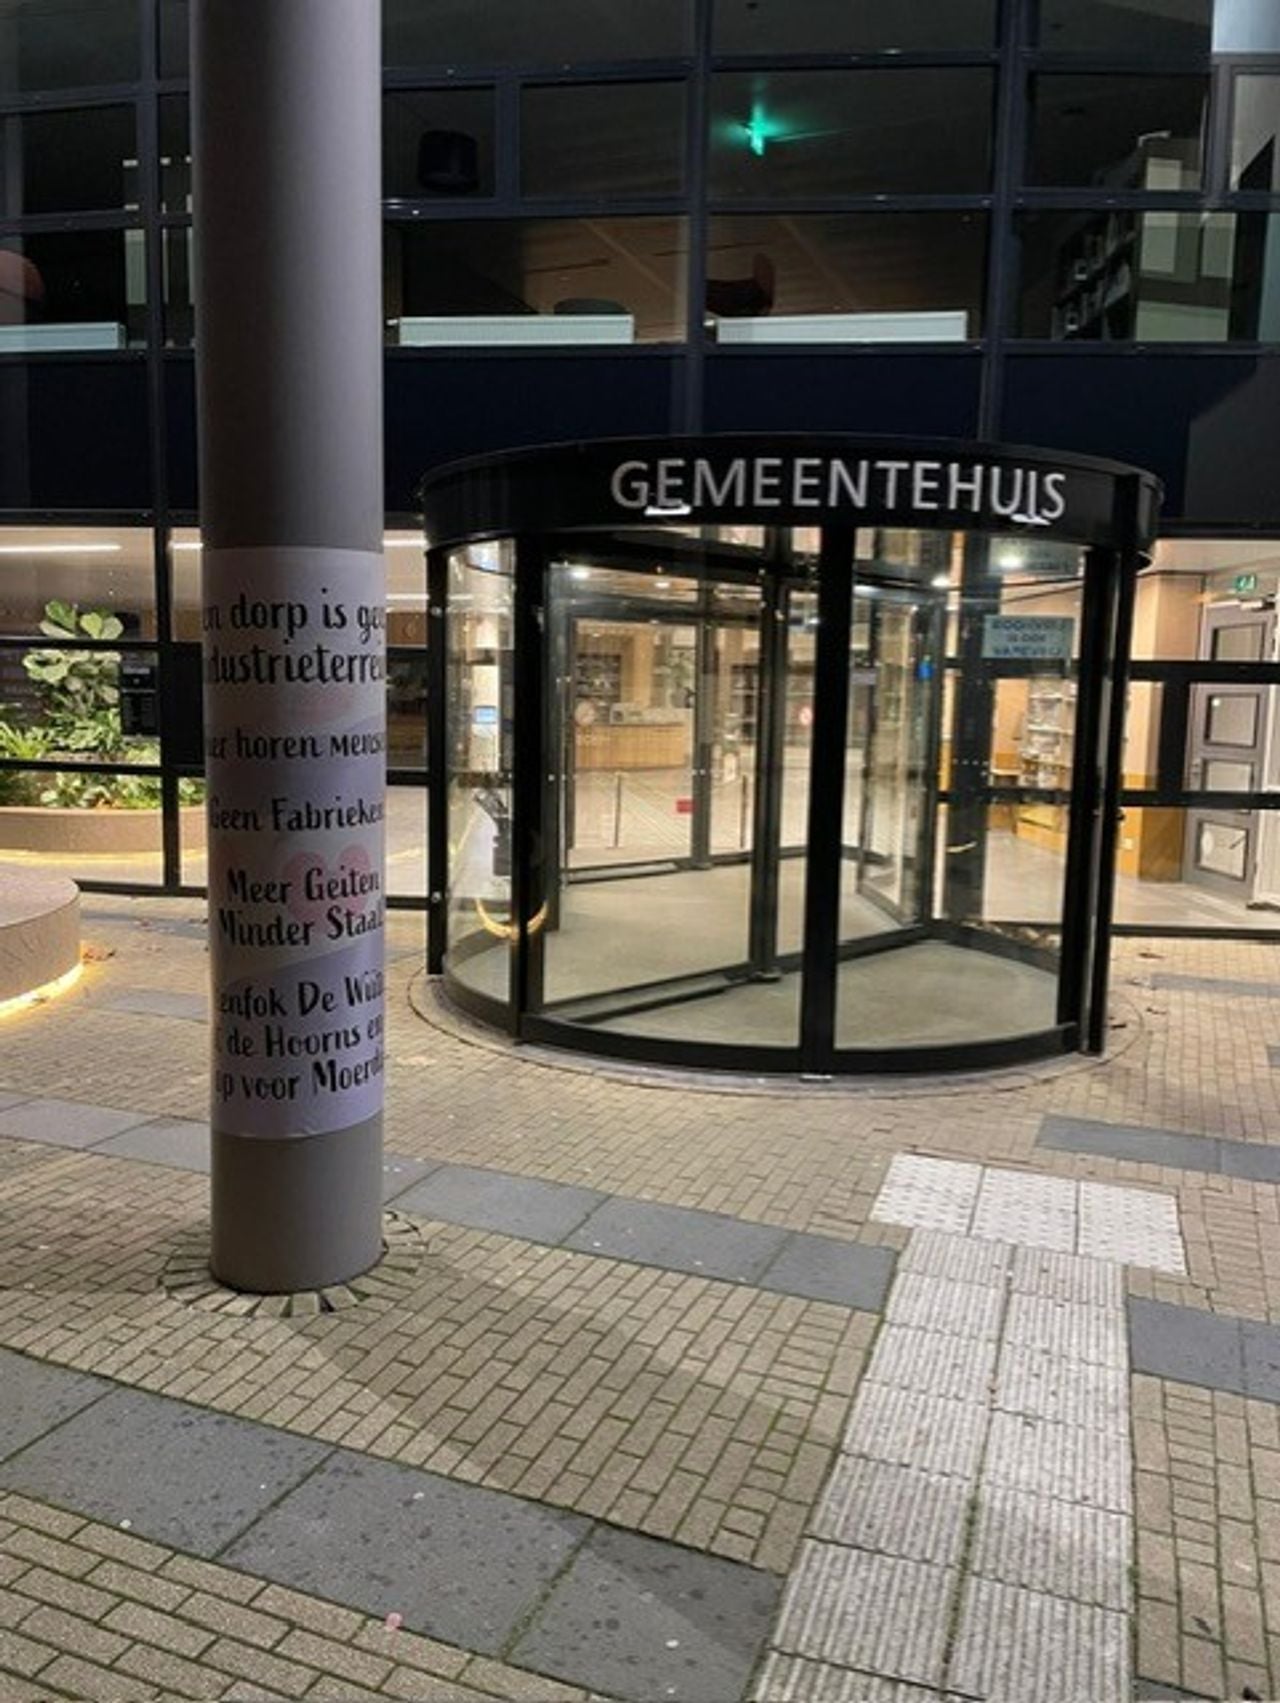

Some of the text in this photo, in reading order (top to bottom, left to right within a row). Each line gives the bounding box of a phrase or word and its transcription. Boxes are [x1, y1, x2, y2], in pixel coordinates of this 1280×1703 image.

[611, 458, 1065, 518] GEMEENTEHUIS
[231, 592, 308, 638] dorp
[321, 587, 347, 629] is
[236, 726, 323, 760] horen
[227, 865, 380, 903] Meer Geiten
[219, 908, 315, 946] Minder
[298, 981, 337, 1016] De
[226, 1028, 256, 1057] de
[265, 1024, 361, 1057] Hoorns
[241, 1075, 300, 1100] voor
